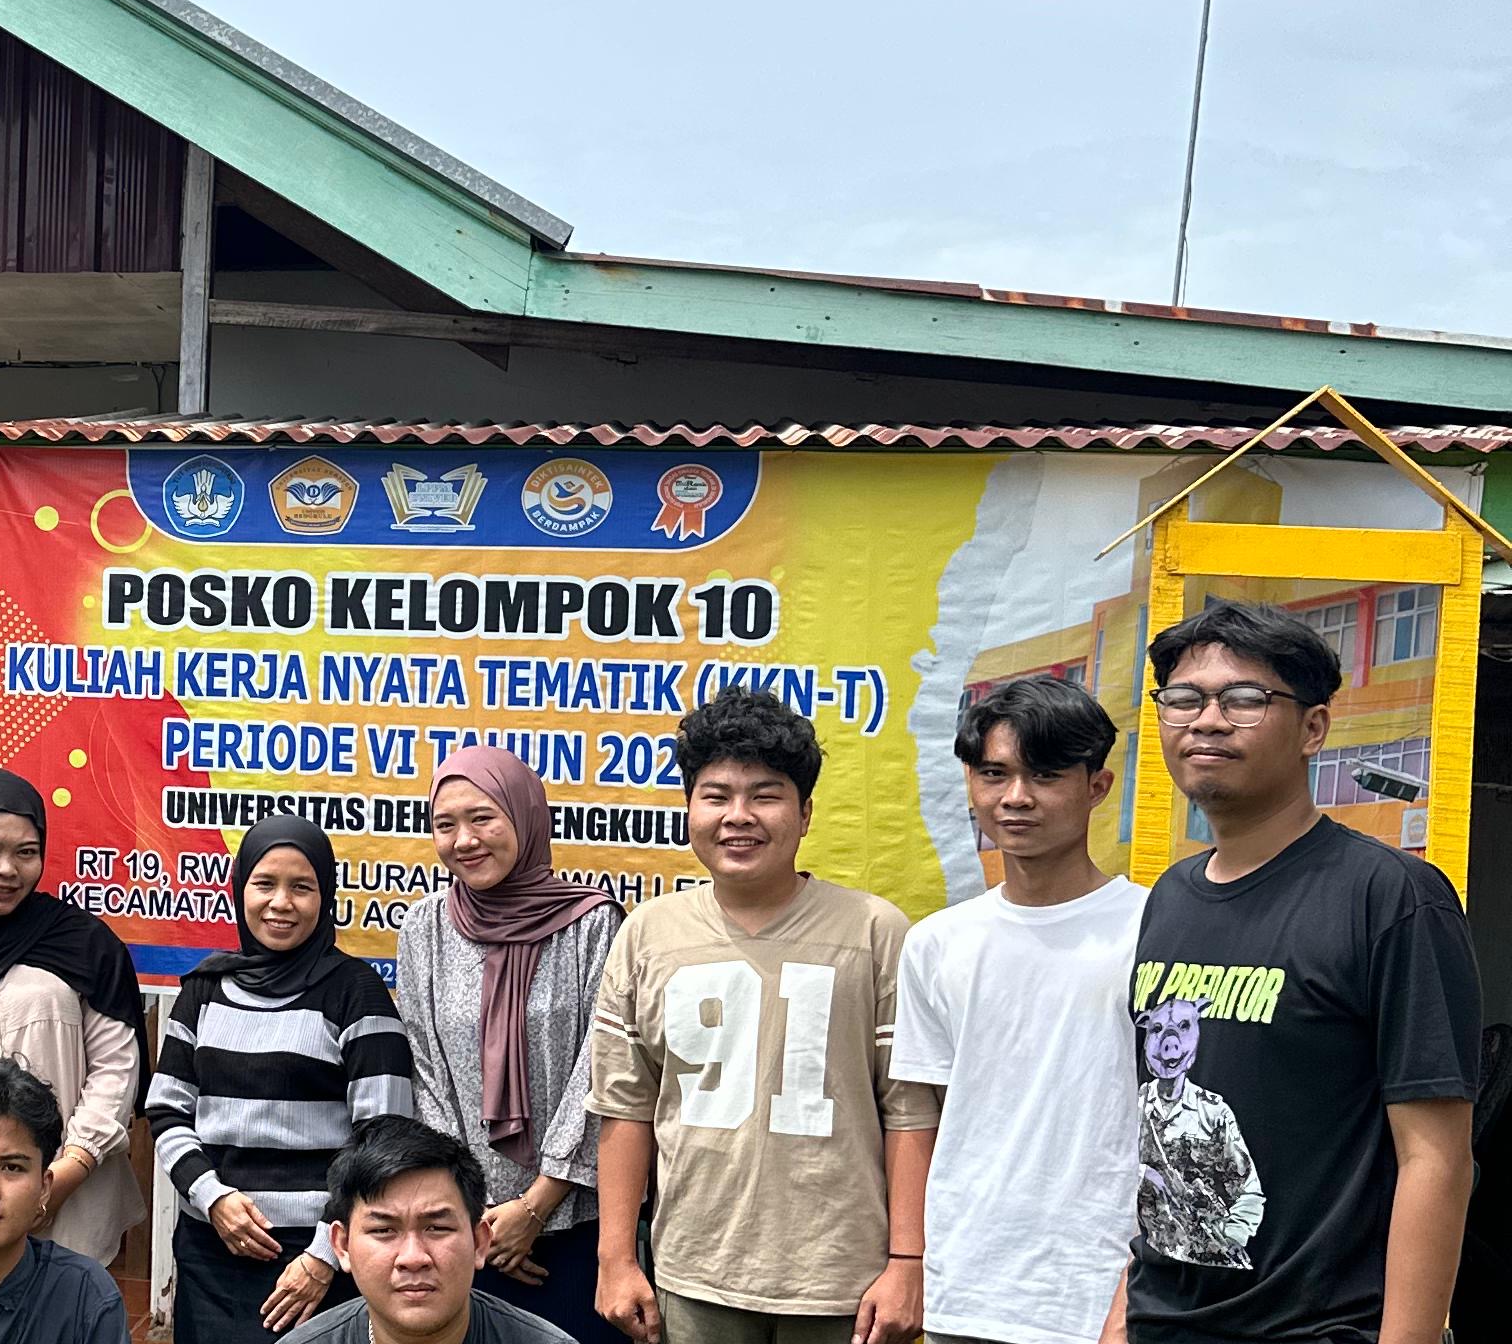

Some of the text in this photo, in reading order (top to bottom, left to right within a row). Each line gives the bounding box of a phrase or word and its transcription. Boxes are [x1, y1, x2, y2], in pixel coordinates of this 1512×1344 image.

[531, 463, 603, 490] DIKTISAINTEK
[531, 511, 600, 532] BERDAMPAK
[107, 573, 773, 640] POSKO KELOMPOK 10
[8, 646, 161, 695] KULIAH
[177, 651, 308, 701] KERJA
[323, 655, 467, 706] NYATA
[479, 659, 686, 711] TEMATIK
[166, 722, 355, 772] PERIODE
[368, 727, 416, 774] VI
[599, 735, 683, 786] 202
[167, 790, 365, 831] UNIVERSITAS
[549, 805, 689, 846] ENGKULU
[77, 849, 117, 877] RT
[127, 853, 170, 886] 19,
[178, 855, 231, 884] RW
[62, 884, 234, 921] KECAMATA
[1157, 962, 1286, 1024] PREDATOR
[663, 960, 836, 1137] 91
